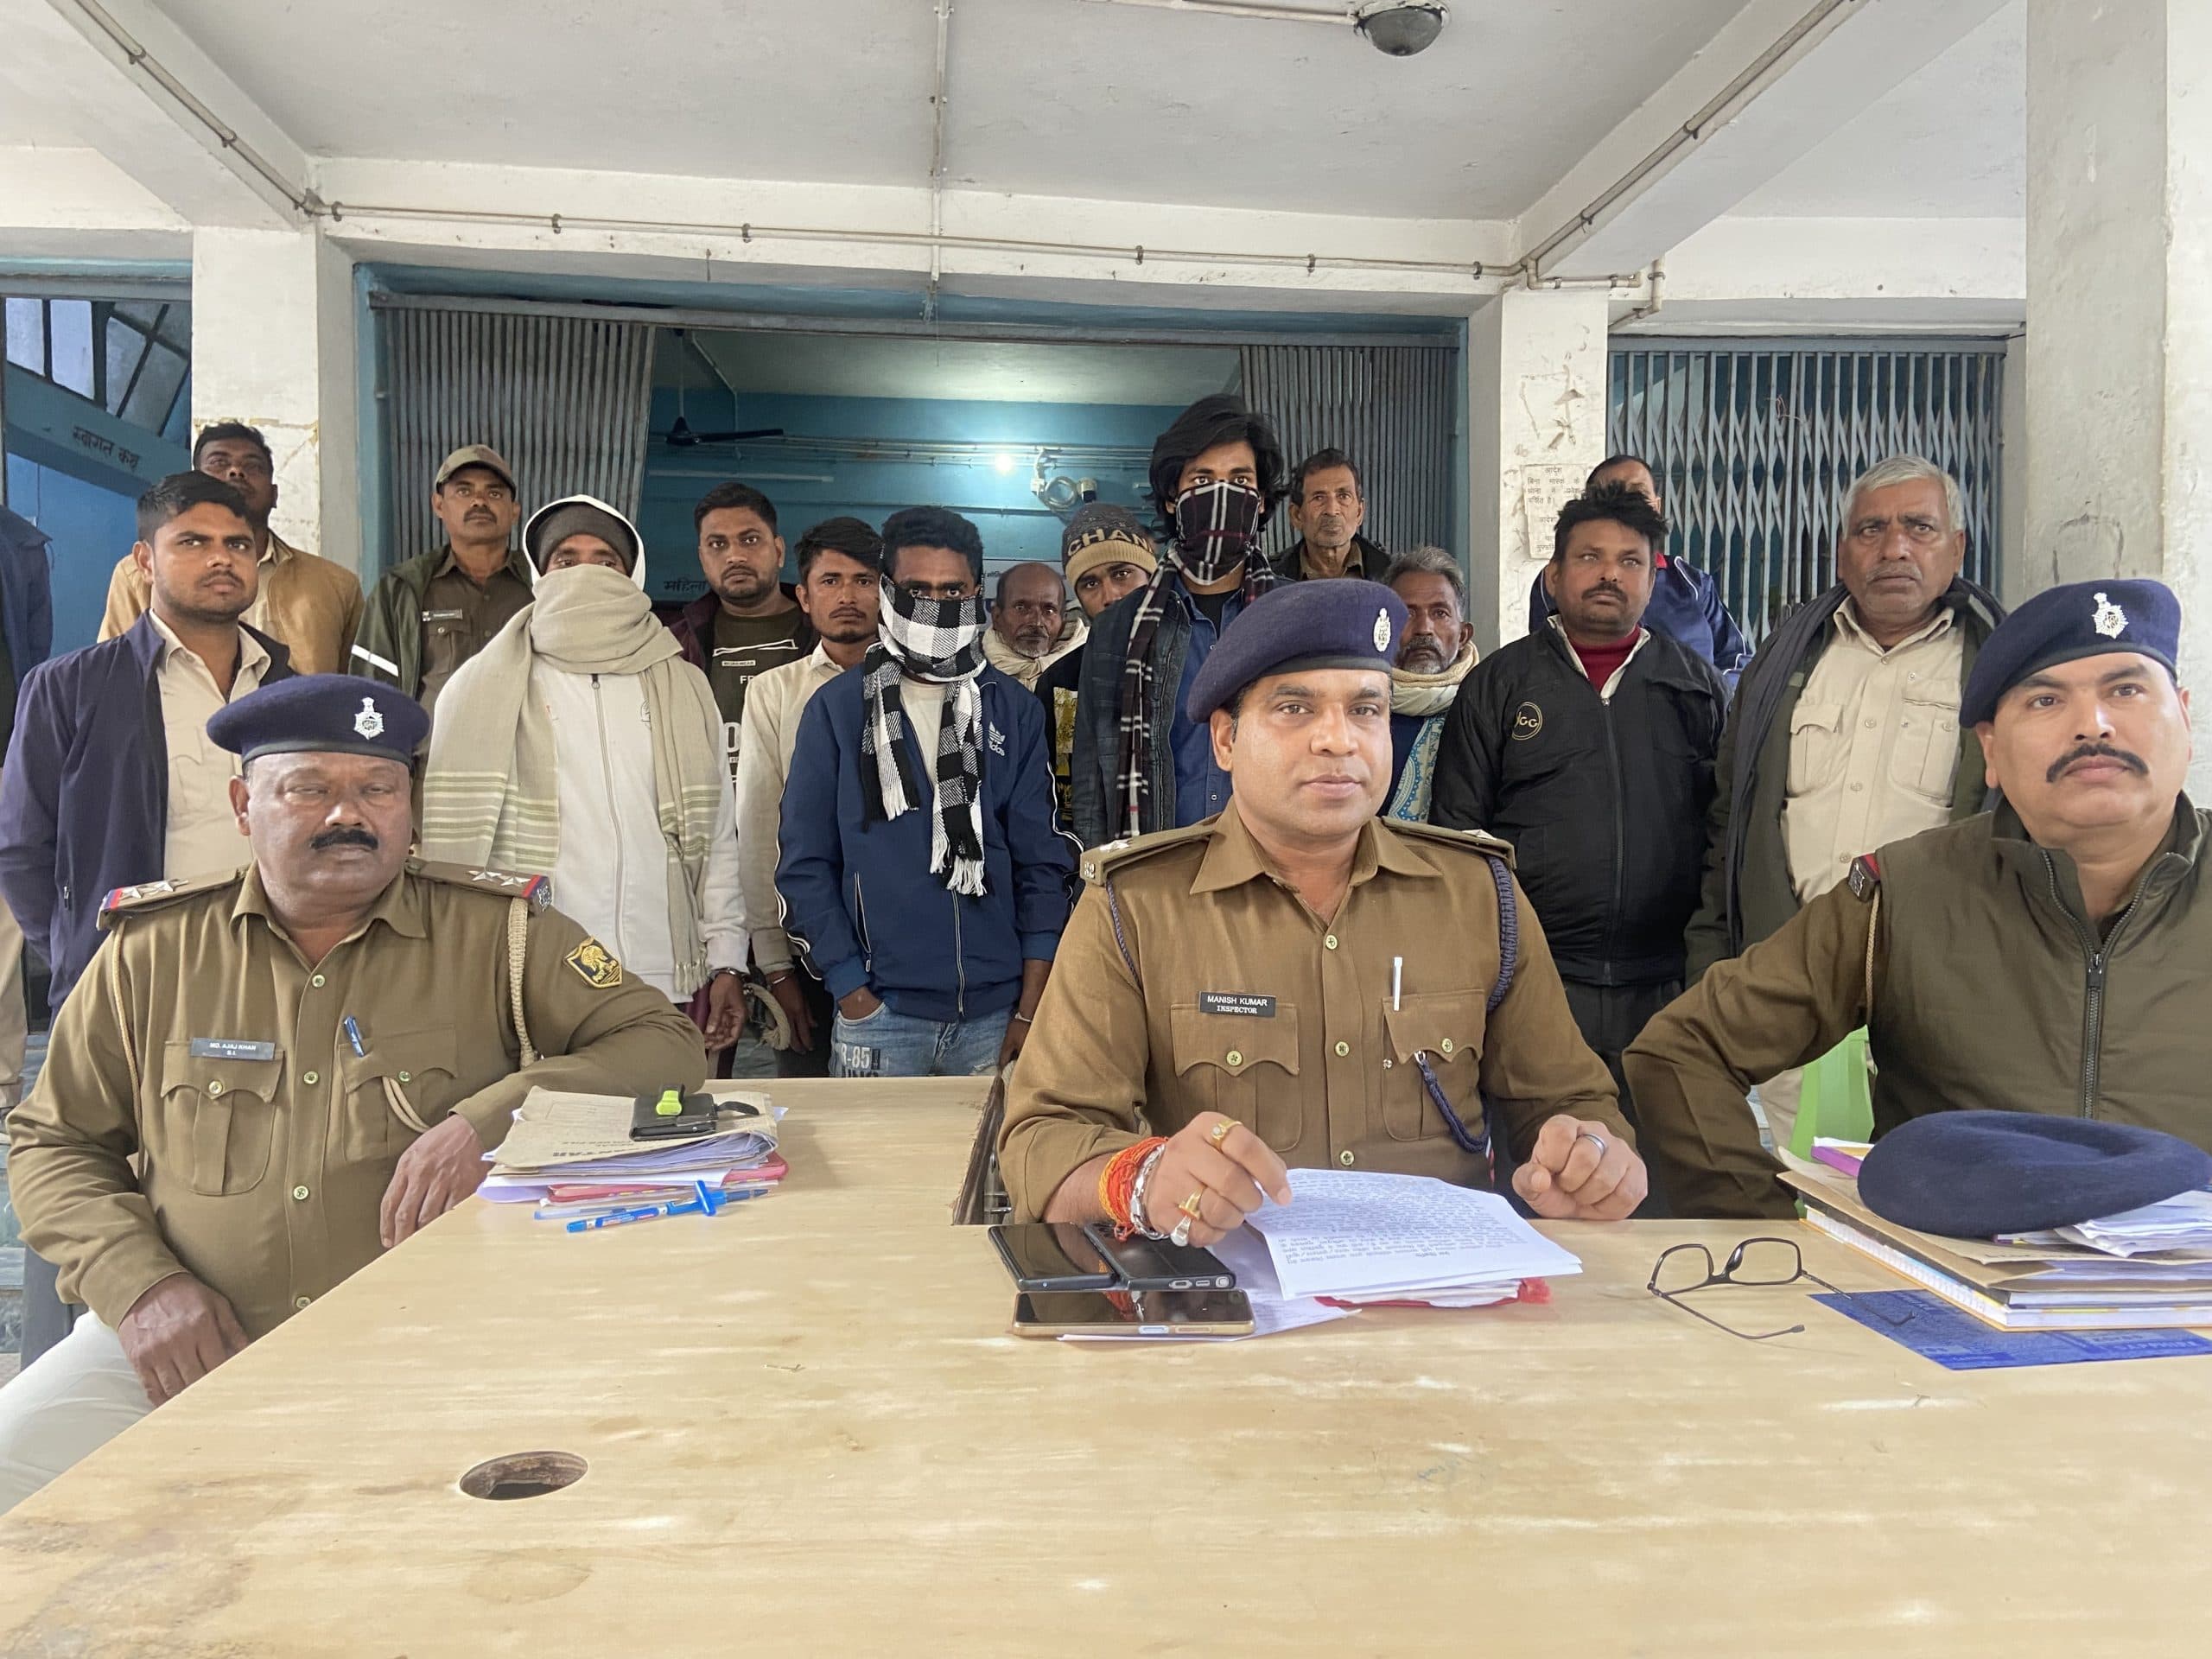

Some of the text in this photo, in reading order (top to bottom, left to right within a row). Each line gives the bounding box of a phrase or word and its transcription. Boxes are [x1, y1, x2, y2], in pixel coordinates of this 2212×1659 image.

[1207, 995, 1268, 1007] MANISH KUMAR
[1216, 1005, 1258, 1014] INSPECTOR
